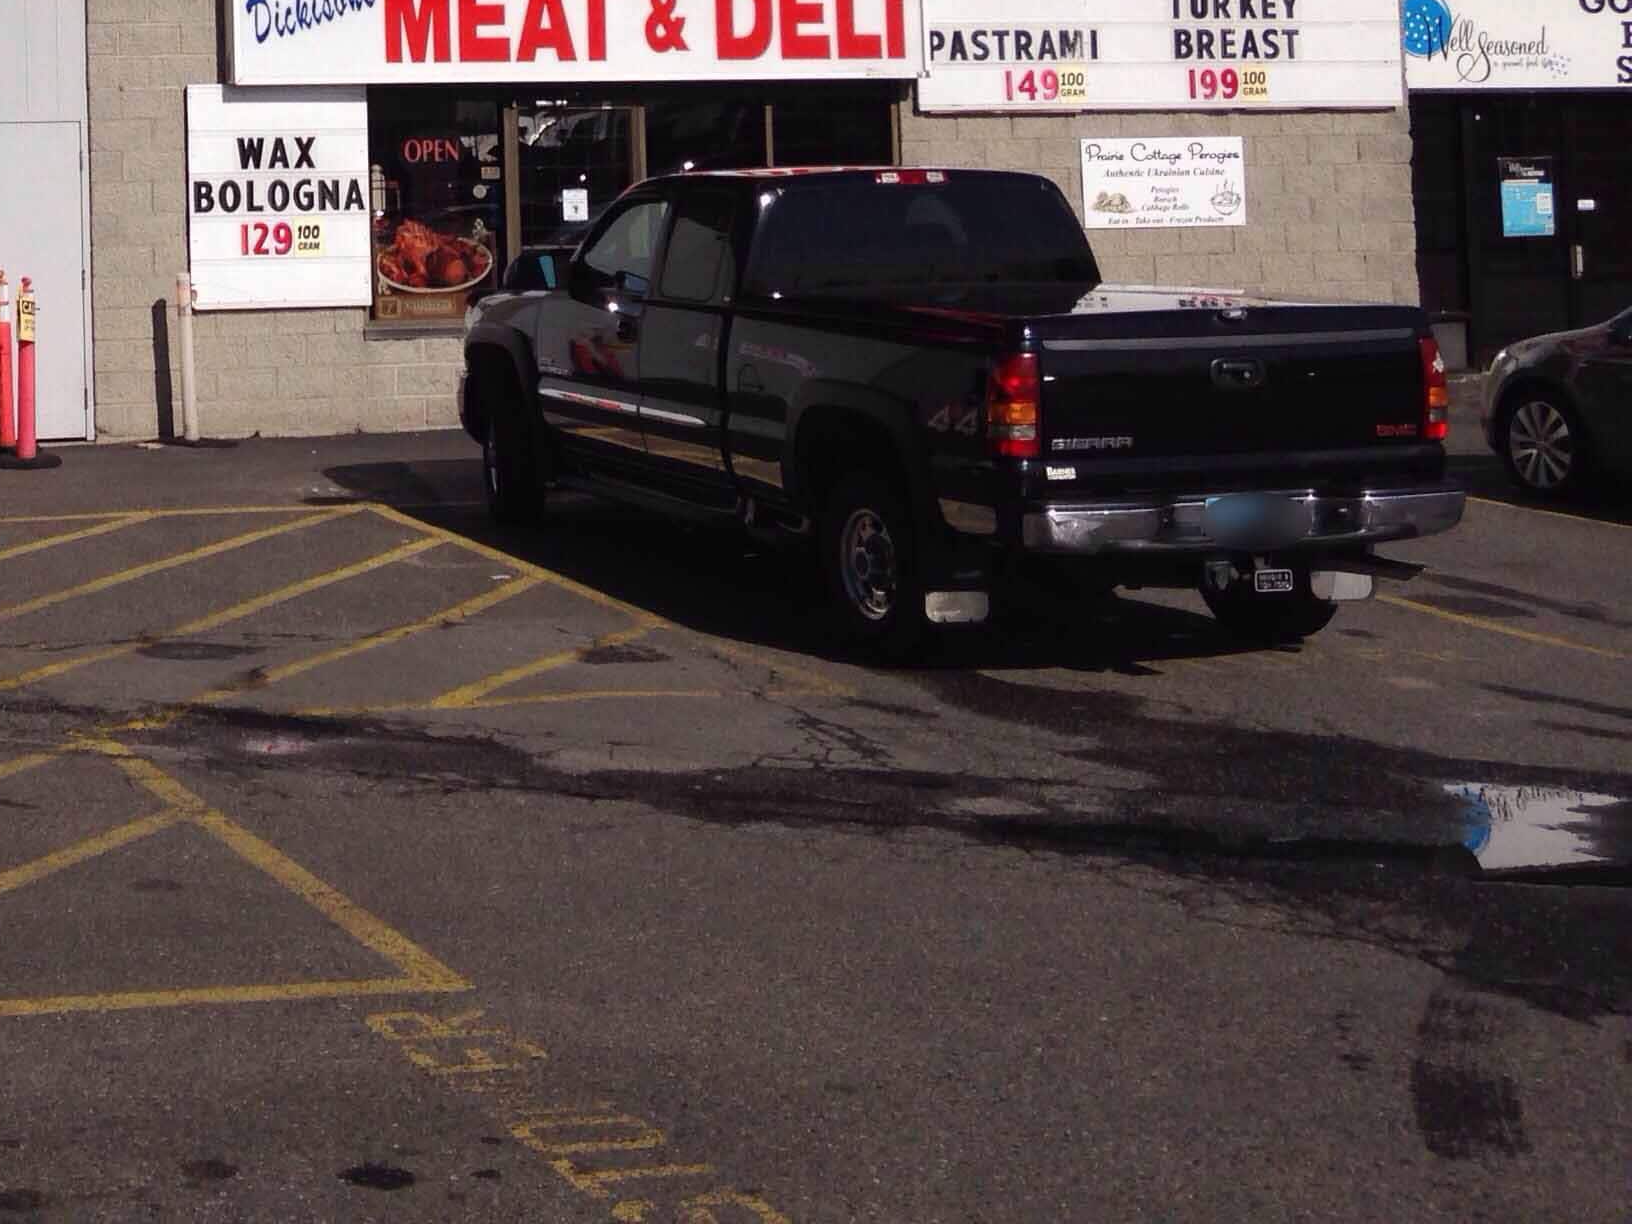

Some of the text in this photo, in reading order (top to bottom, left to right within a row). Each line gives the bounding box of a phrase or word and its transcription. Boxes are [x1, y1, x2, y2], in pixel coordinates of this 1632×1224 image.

[929, 29, 1099, 61] PASTRAMI
[1173, 28, 1300, 60] BREAST
[1004, 69, 1085, 101] 149 100
[1060, 88, 1086, 97] GRAM
[1187, 68, 1267, 100] 199 100
[1242, 87, 1268, 96] GRAM
[235, 136, 317, 171] WAX
[403, 138, 461, 163] OPEN
[1085, 142, 1241, 165] Prairie Cottage Perogies
[192, 178, 367, 214] BOLOGNA
[239, 222, 321, 257] 129 100
